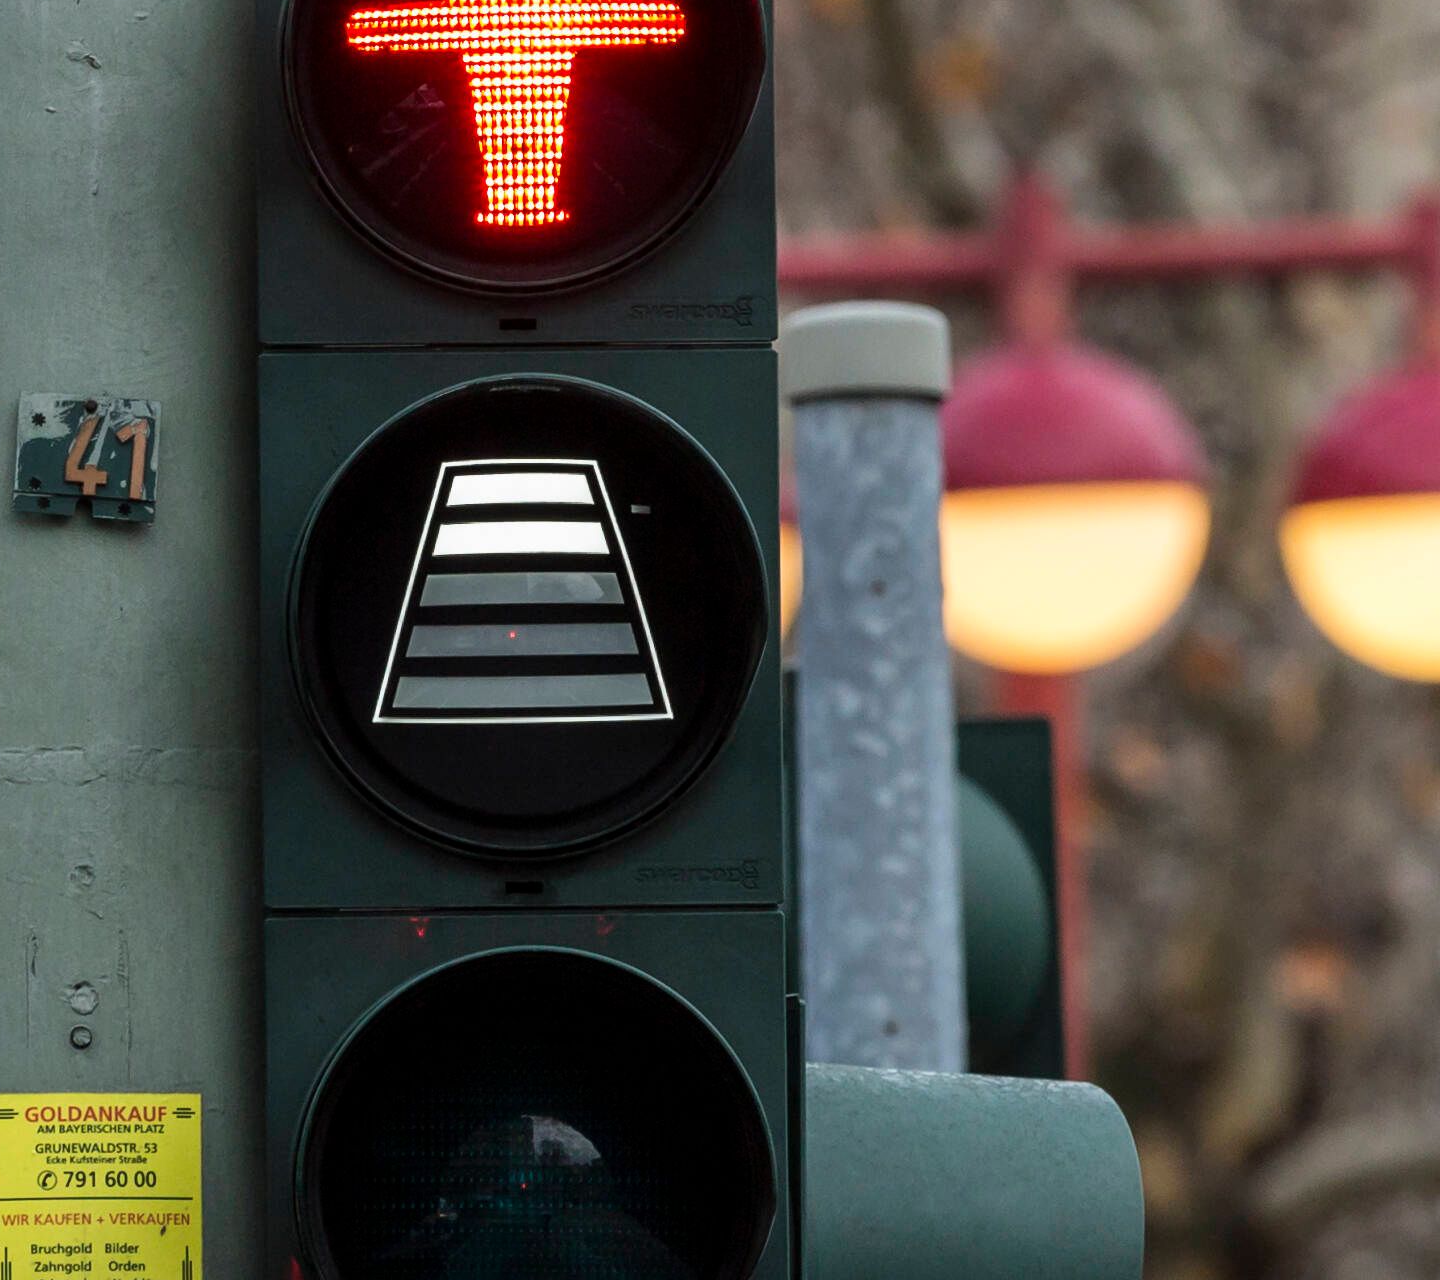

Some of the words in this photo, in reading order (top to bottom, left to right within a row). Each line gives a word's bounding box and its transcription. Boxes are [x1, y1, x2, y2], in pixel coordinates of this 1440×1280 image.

[64, 416, 148, 500] 41
[24, 1106, 168, 1123] GOLDANKAUF
[36, 1124, 56, 1134] AM
[58, 1124, 131, 1134] BAYERISCHEN
[134, 1124, 165, 1134] PLATZ
[34, 1143, 140, 1154] GRUNEWALDSTR.
[144, 1143, 158, 1154] 53
[46, 1156, 67, 1164] Ecke
[69, 1156, 116, 1165] Kufsteiner
[119, 1156, 148, 1164] Straße
[63, 1171, 97, 1188] 791
[105, 1171, 128, 1188] 60
[134, 1171, 157, 1188] 00
[1, 1214, 29, 1226] WIR
[34, 1214, 92, 1225] KAUFEN
[96, 1216, 105, 1224] +
[109, 1213, 191, 1225] VERKAUFEN
[30, 1243, 93, 1256] Bruchgold
[105, 1243, 140, 1254] Bilder
[34, 1261, 92, 1274] Zahngold
[108, 1261, 146, 1271] Orden
